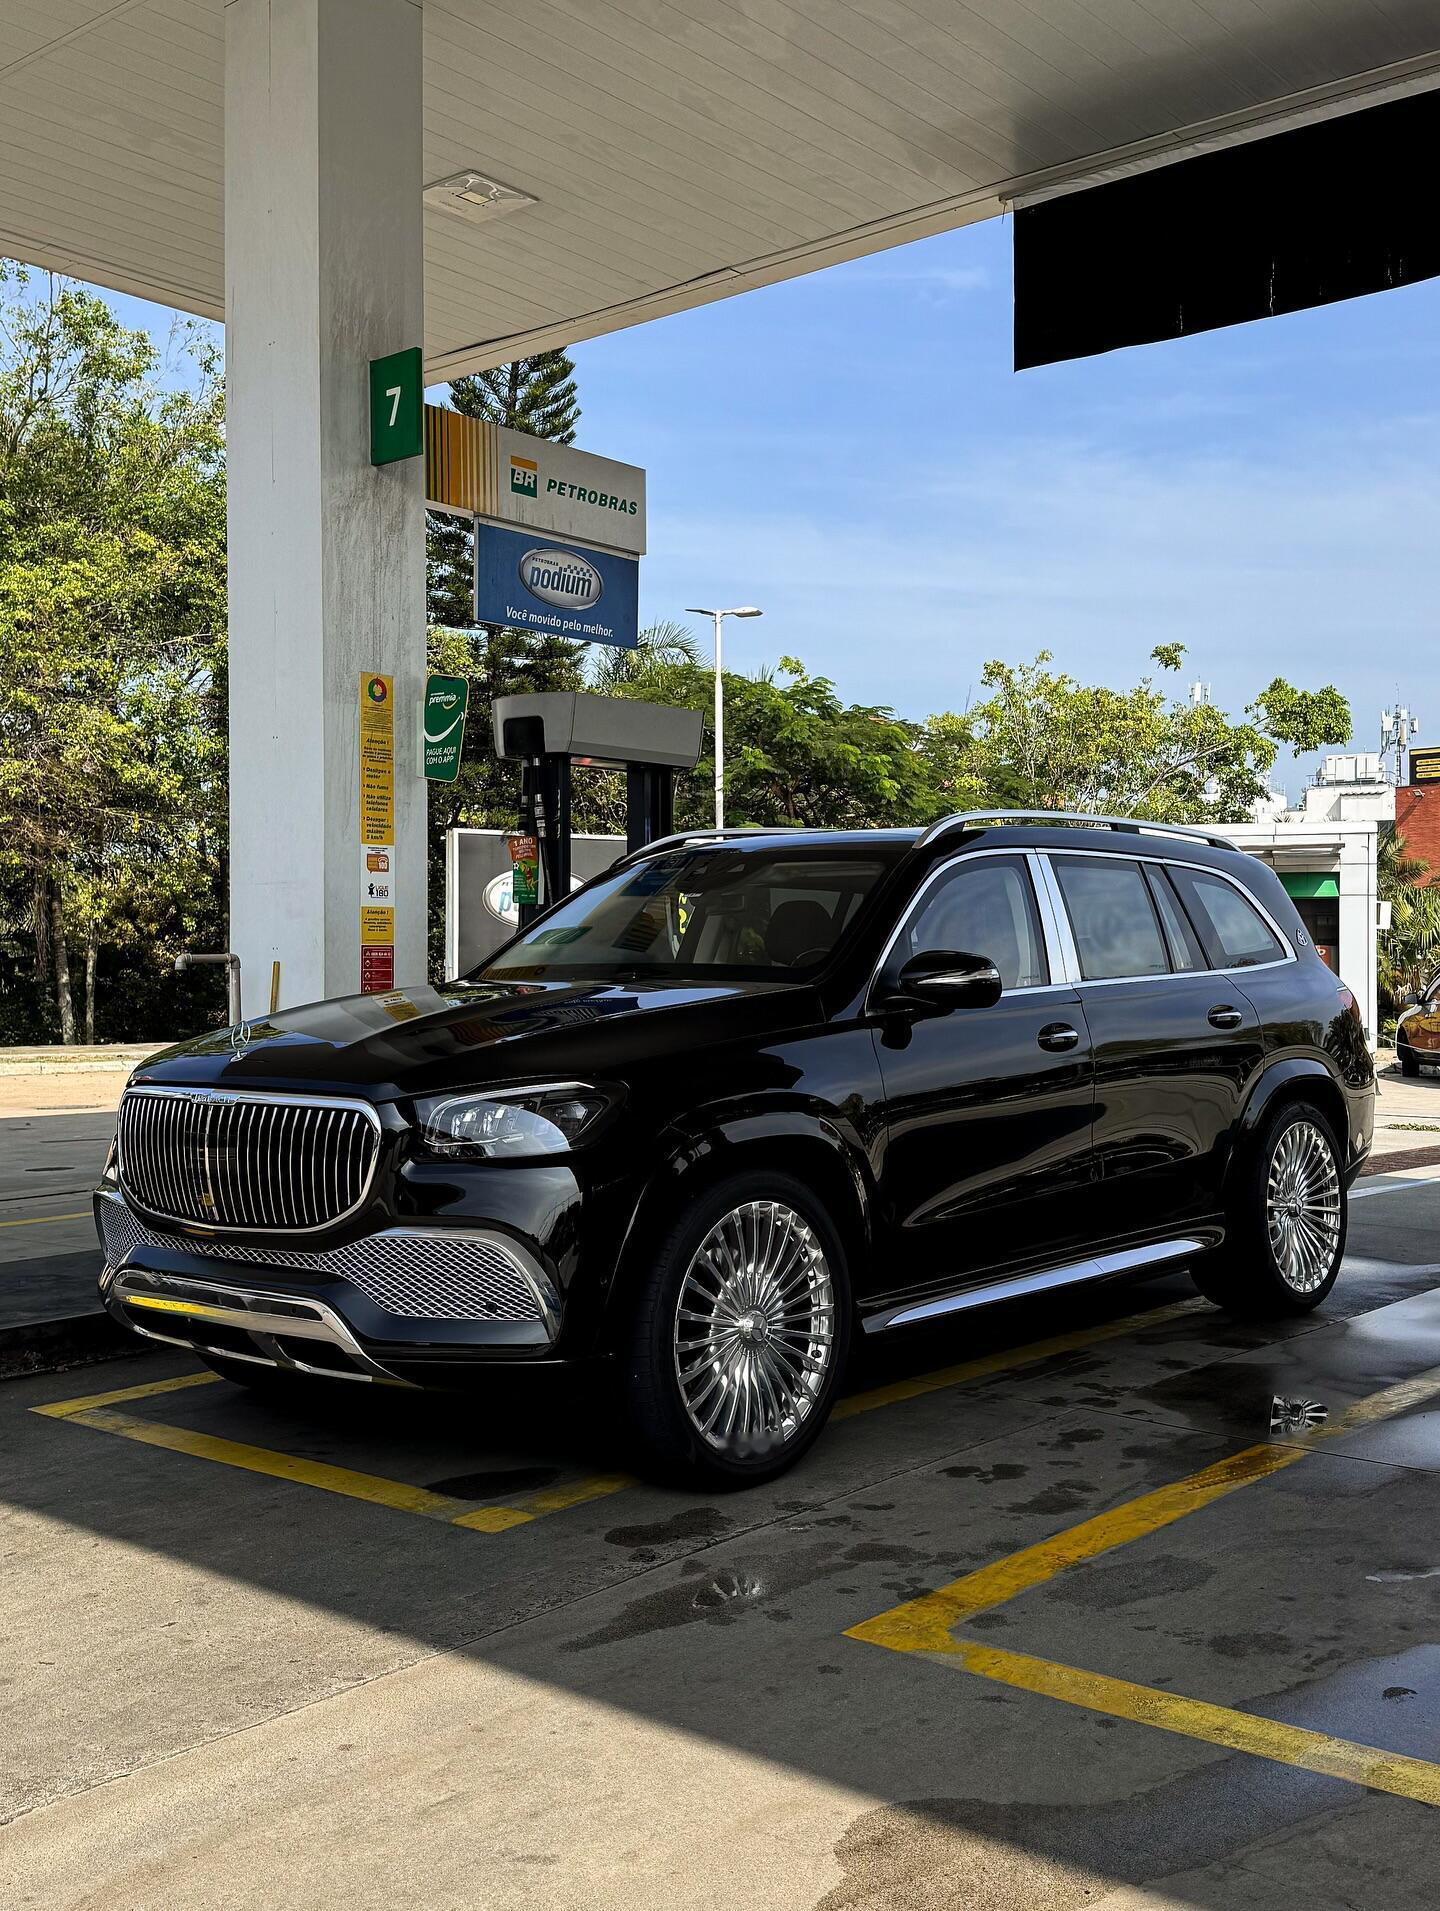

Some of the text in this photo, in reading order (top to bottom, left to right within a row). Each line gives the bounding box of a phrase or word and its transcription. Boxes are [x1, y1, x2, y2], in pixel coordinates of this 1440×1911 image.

[386, 385, 401, 427] 7
[512, 470, 535, 488] BR
[546, 478, 638, 515] PETROBRAS
[530, 566, 592, 598] podium
[506, 605, 614, 638] Você movido pelo melhor.
[428, 692, 457, 706] premmia
[426, 746, 457, 757] PAGUE AQUI
[426, 755, 454, 765] COM O APP
[519, 837, 533, 846] ANO
